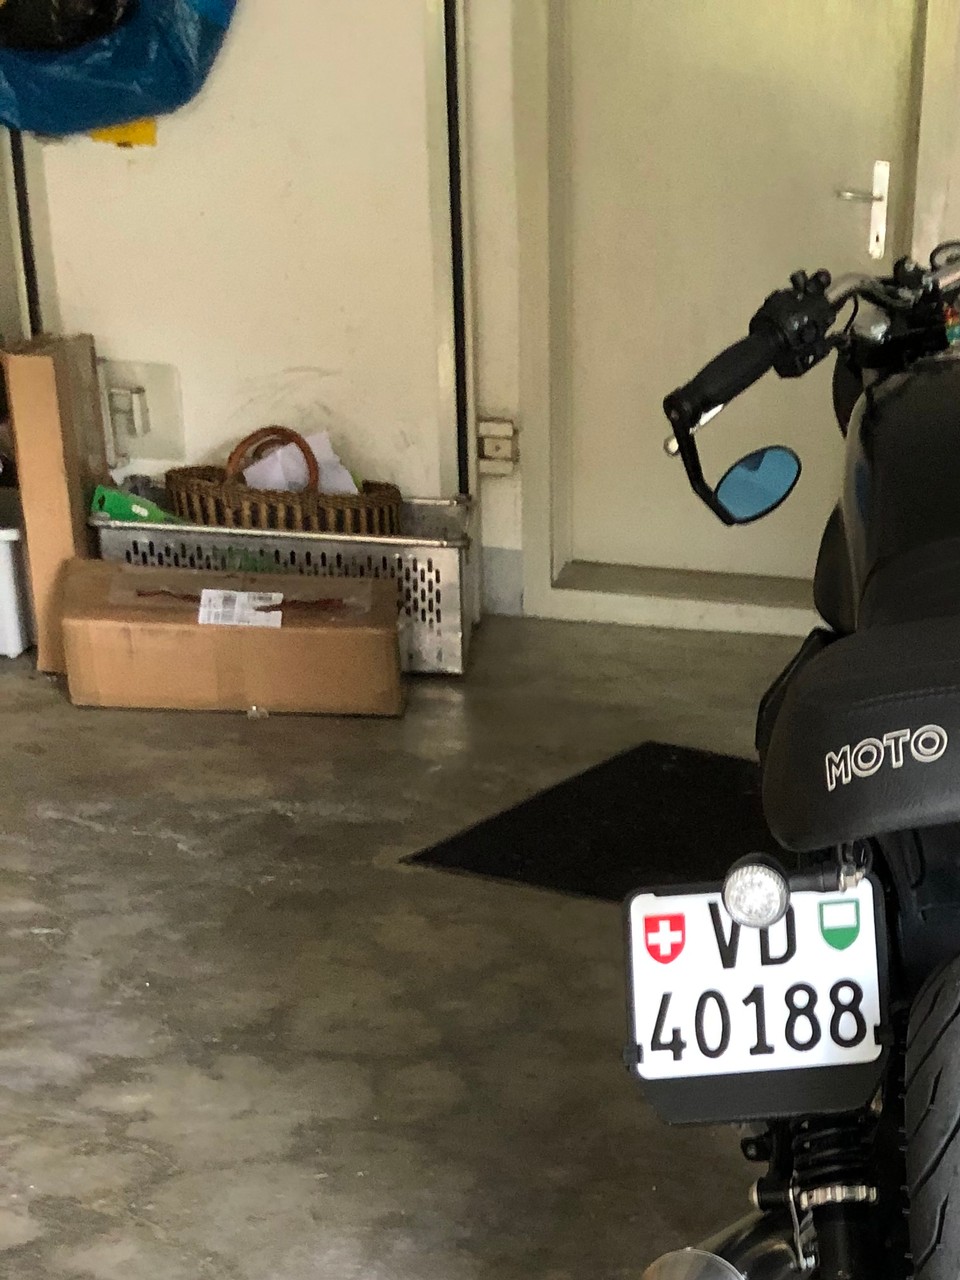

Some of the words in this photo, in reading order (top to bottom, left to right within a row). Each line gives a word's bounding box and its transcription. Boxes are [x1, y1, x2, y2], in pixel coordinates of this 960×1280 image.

[825, 724, 948, 791] MOTO
[708, 901, 797, 969] VD
[651, 978, 867, 1061] 40188
